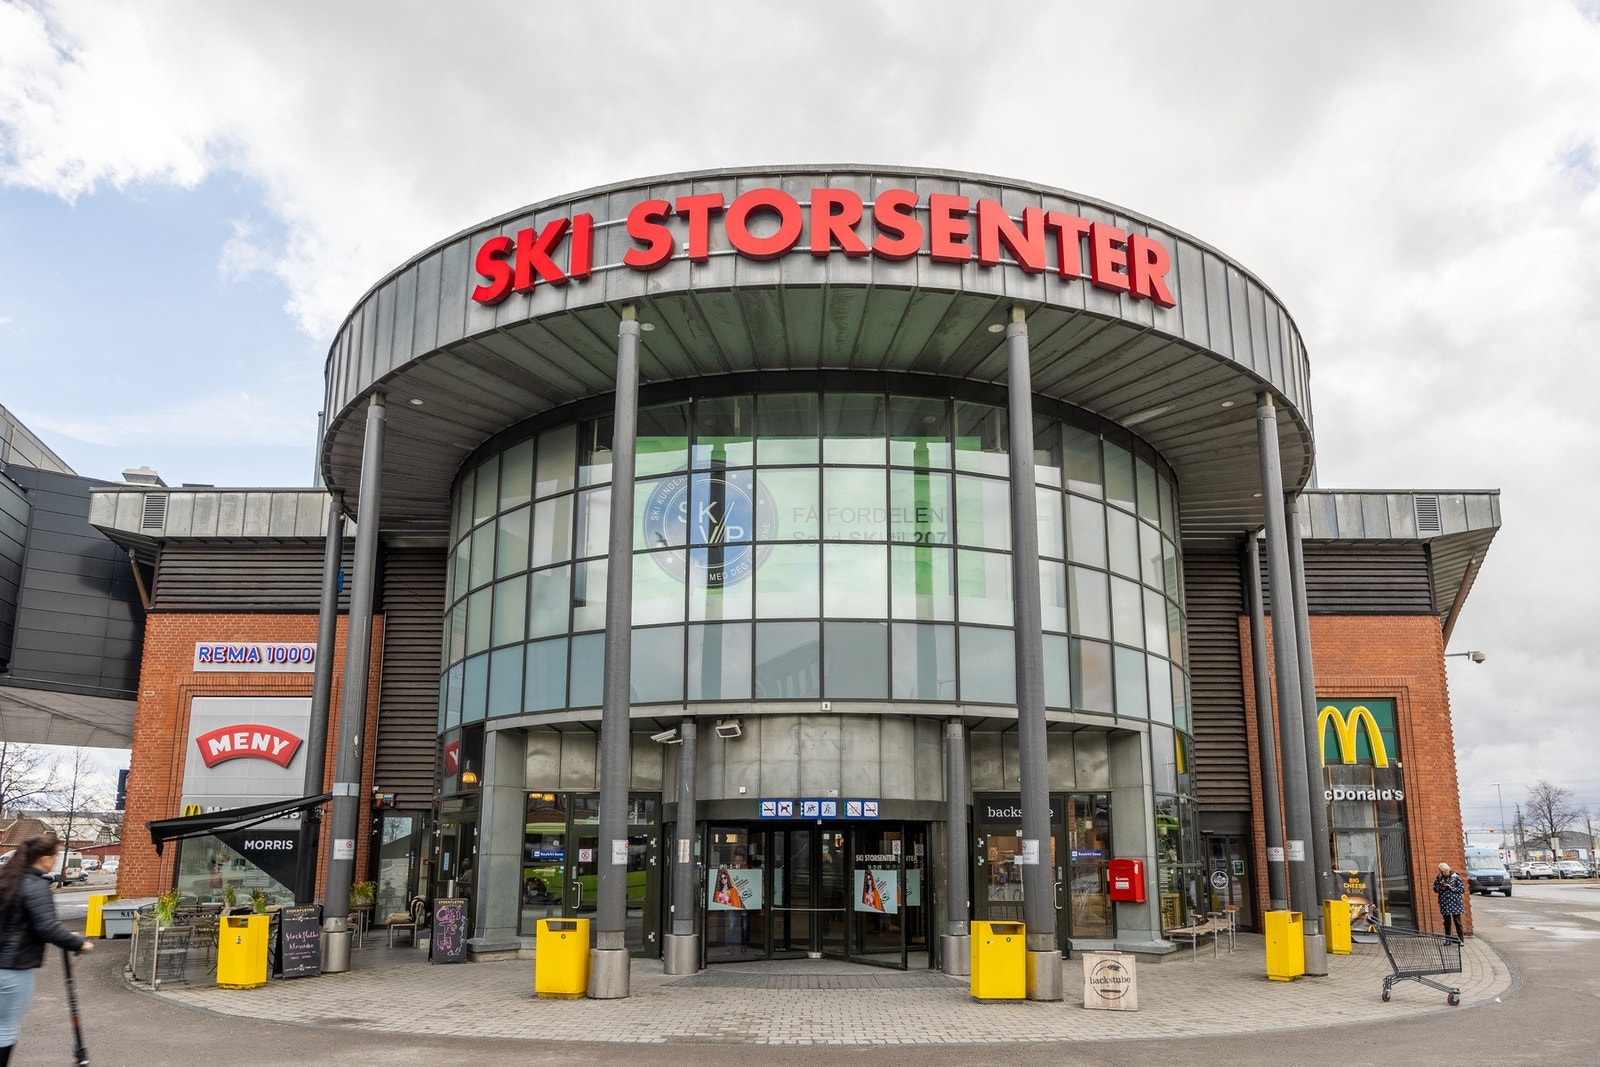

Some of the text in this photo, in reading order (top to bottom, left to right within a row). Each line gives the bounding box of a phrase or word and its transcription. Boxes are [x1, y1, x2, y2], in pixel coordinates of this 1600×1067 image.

[472, 188, 1176, 308] SKI STORSENTER
[793, 505, 819, 523] FÅ
[709, 571, 727, 581] MED
[730, 563, 748, 576] DEG
[198, 645, 314, 663] REMA 1000
[208, 732, 289, 756] MENY
[1324, 788, 1404, 801] cDonald's
[987, 806, 1054, 818] backse
[244, 840, 293, 850] MORRIS
[1089, 975, 1131, 984] backstube
